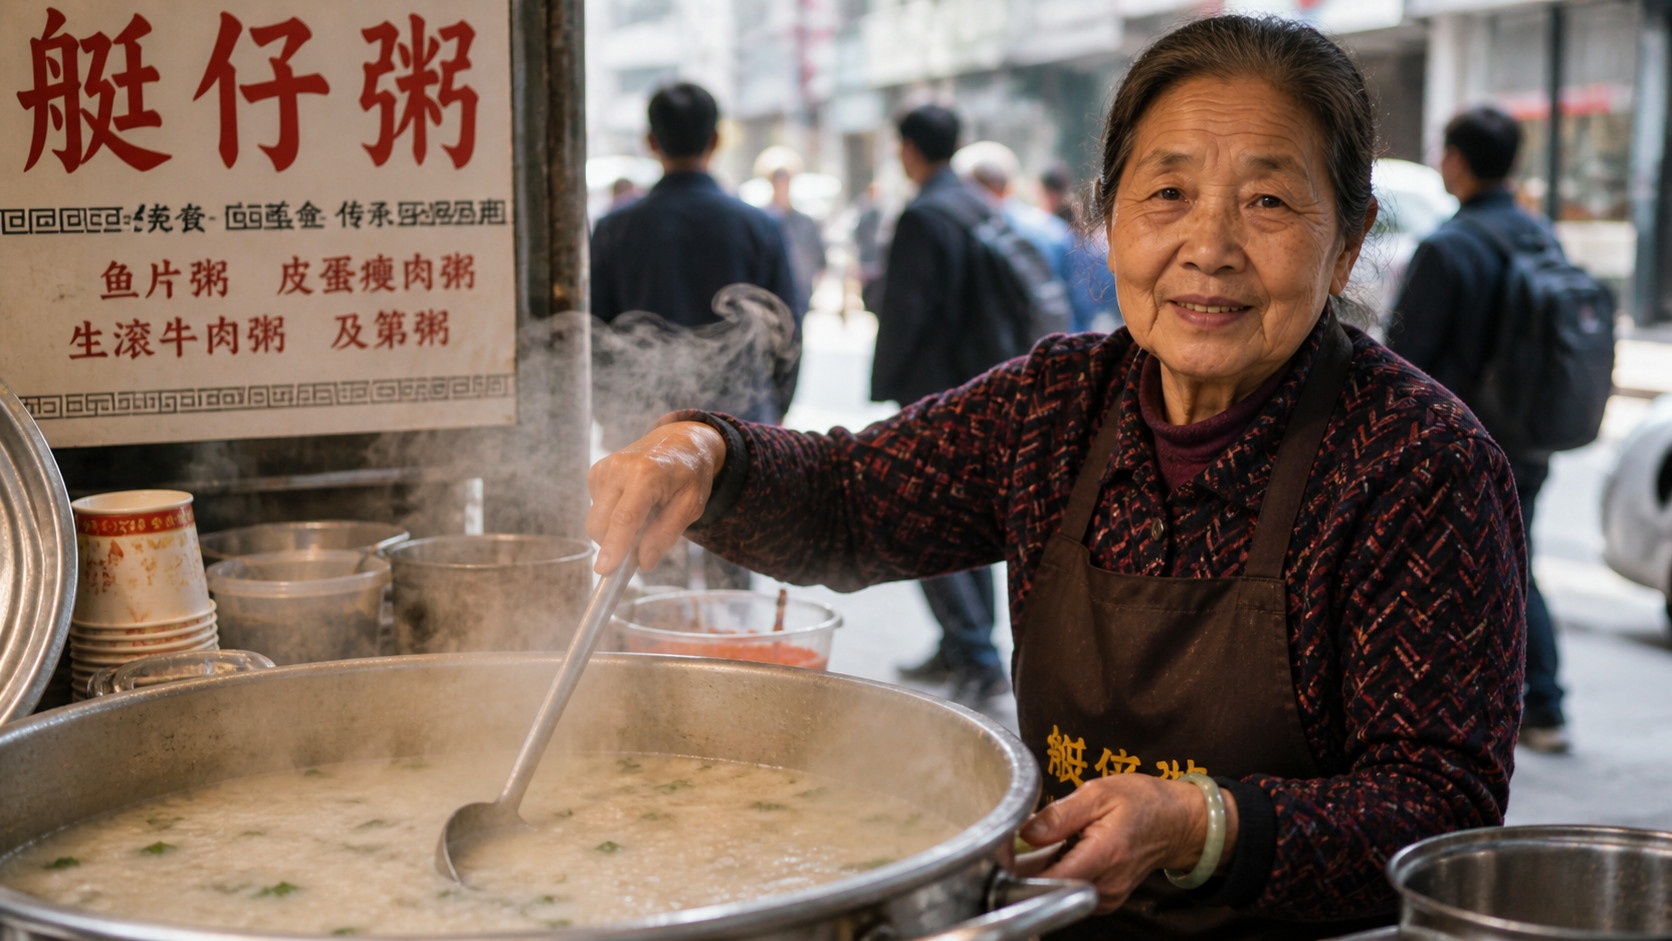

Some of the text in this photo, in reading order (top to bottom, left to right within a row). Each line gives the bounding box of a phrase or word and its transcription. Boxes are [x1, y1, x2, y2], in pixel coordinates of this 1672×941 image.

[16, 7, 479, 174] 艇仔粥
[335, 201, 394, 229] 传承
[100, 252, 476, 300] 鱼片粥 皮蛋瘦肉粥
[69, 309, 450, 360] 生滚牛肉粥 及第粥
